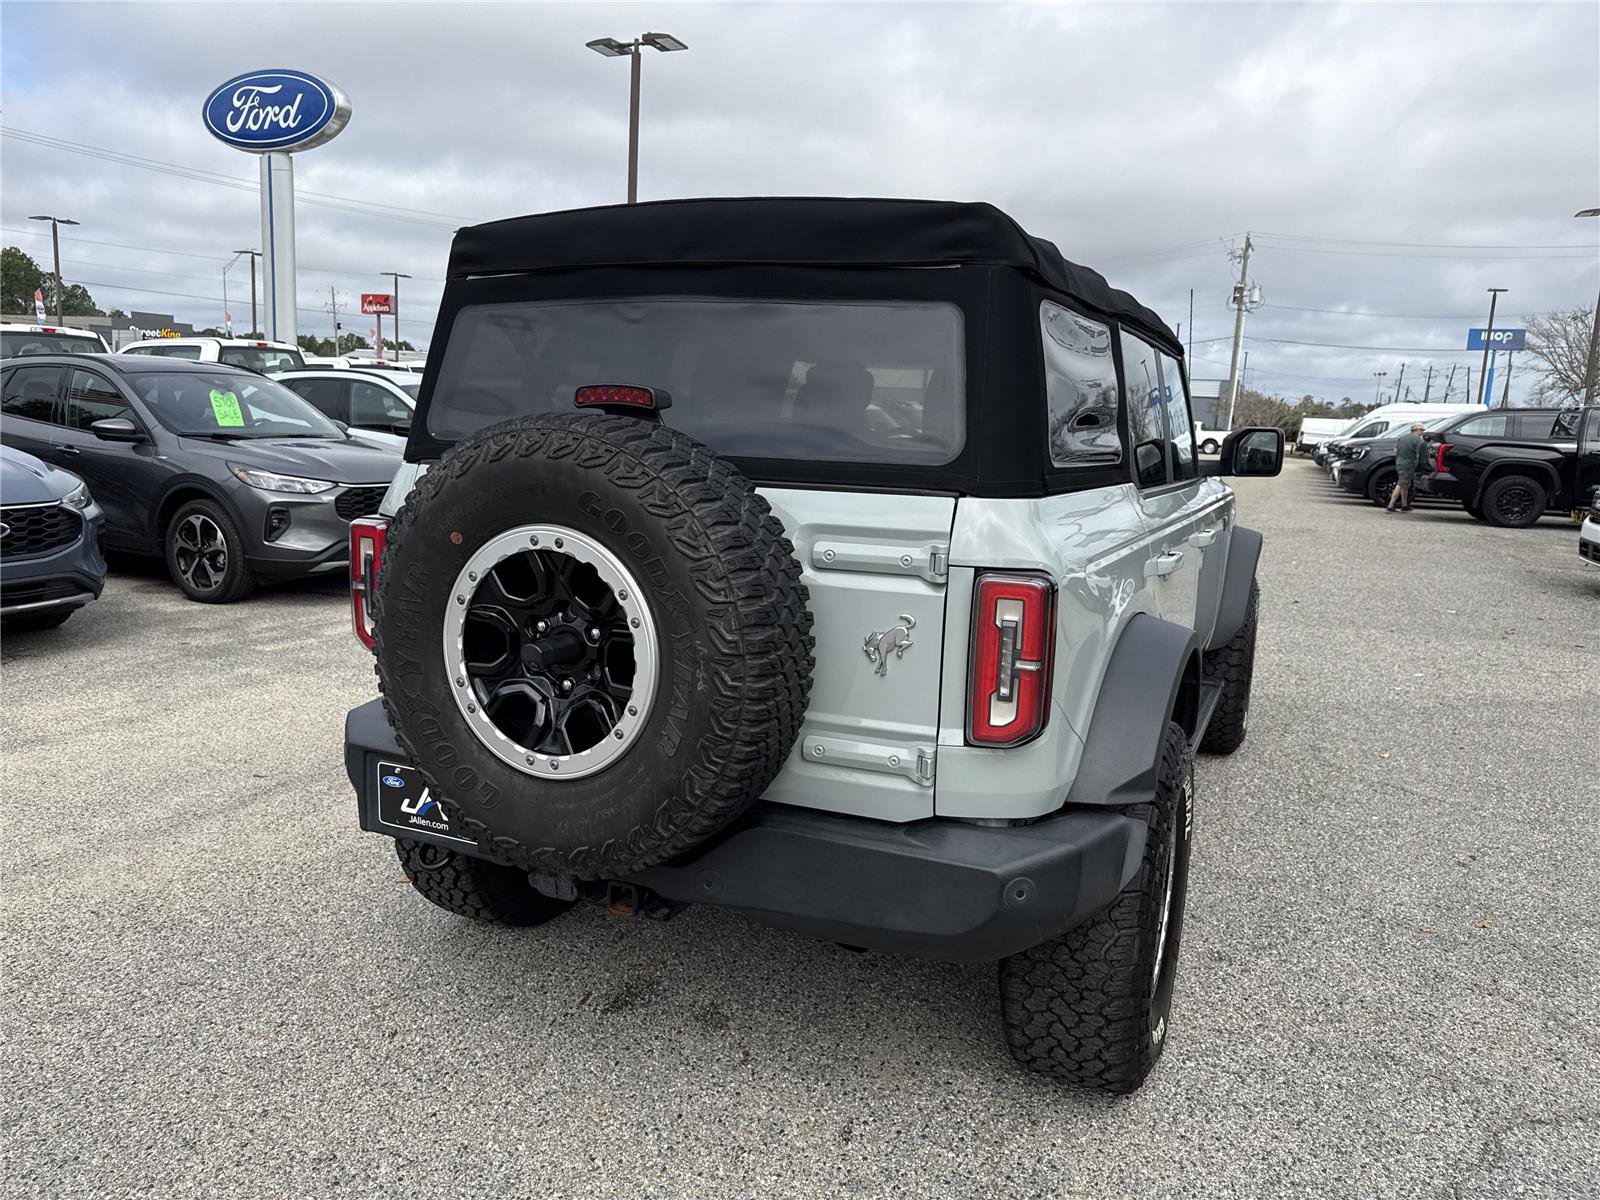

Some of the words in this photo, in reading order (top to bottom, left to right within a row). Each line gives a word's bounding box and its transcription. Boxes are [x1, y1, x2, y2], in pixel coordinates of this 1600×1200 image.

[225, 84, 304, 133] Ford
[217, 408, 240, 420] SALE
[577, 489, 697, 759] GOODYEAR
[394, 561, 501, 810] GOODYEAR
[408, 815, 449, 831] JAllen.com
